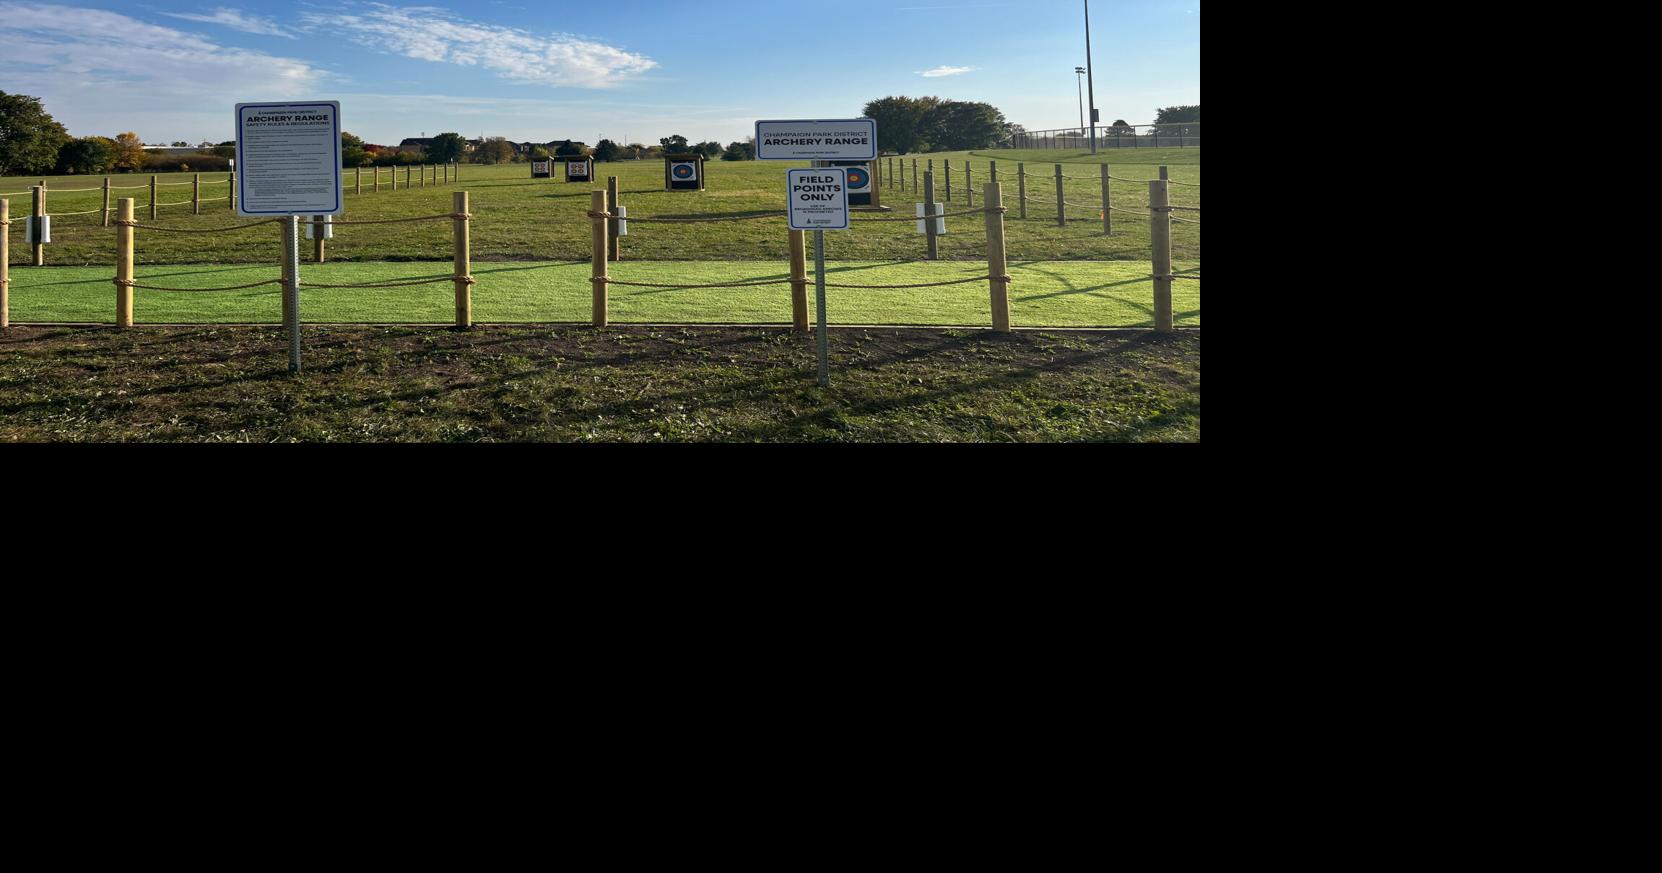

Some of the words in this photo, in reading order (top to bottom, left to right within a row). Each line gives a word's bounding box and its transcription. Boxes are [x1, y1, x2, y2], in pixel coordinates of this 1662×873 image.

[764, 138, 822, 146] ARCHERY
[794, 184, 841, 192] POINTS
[800, 194, 834, 202] ONLY
